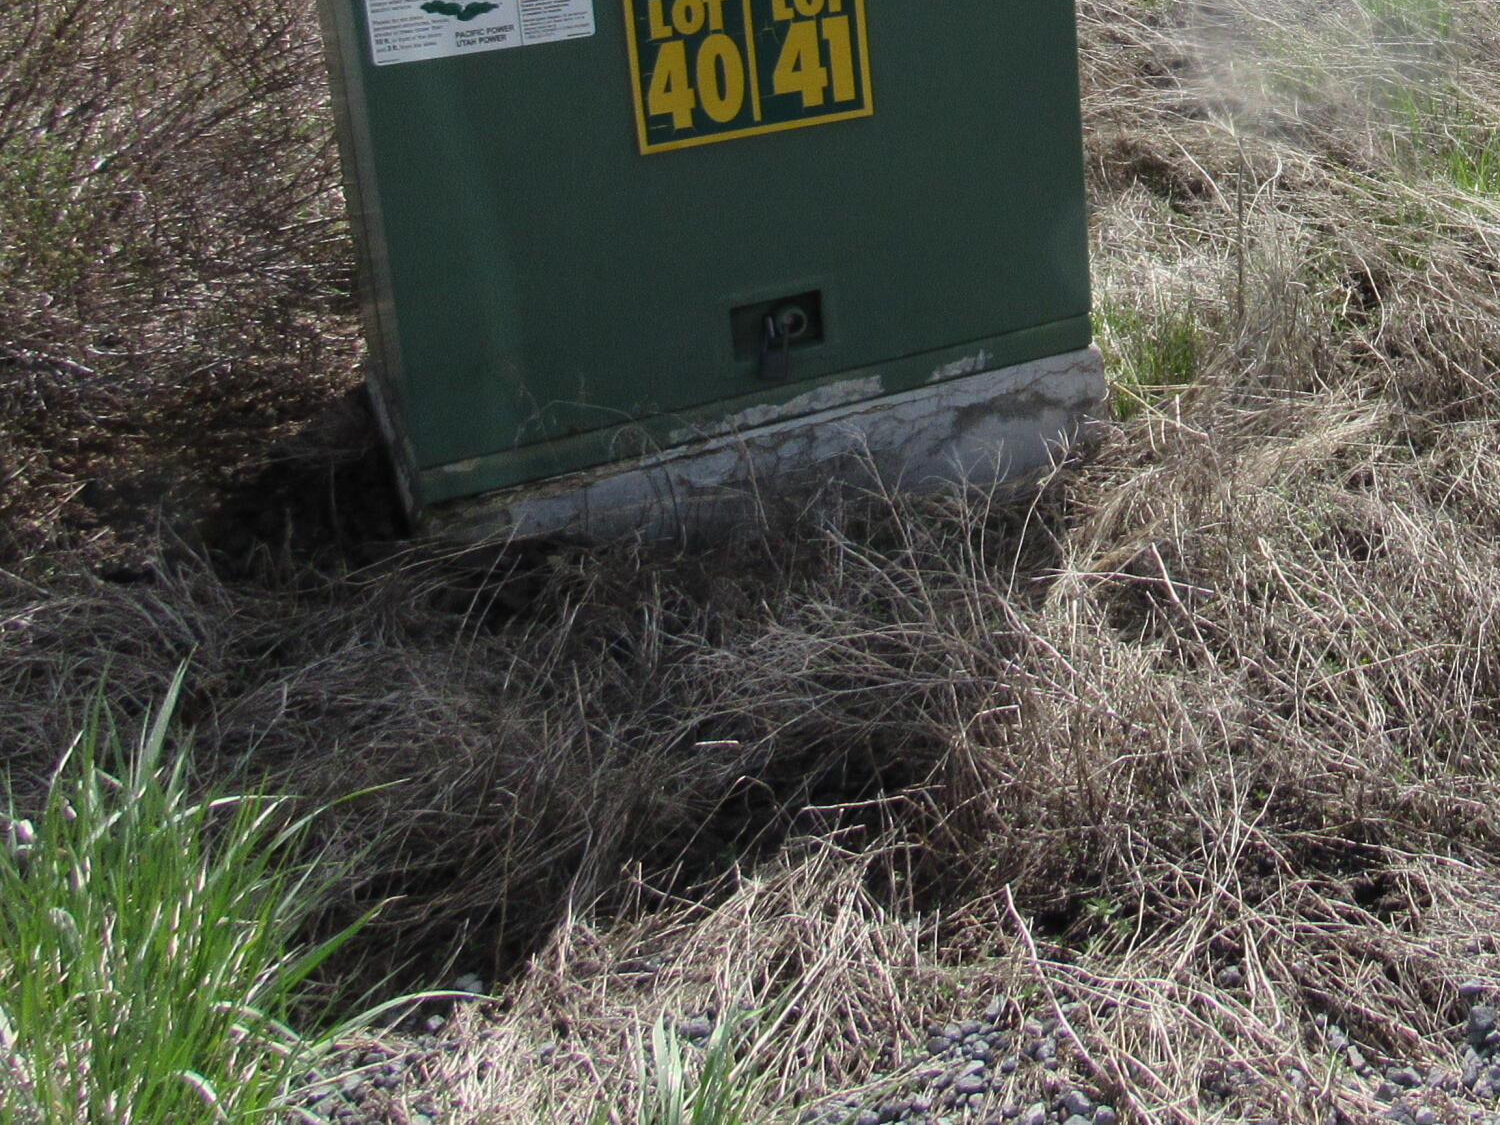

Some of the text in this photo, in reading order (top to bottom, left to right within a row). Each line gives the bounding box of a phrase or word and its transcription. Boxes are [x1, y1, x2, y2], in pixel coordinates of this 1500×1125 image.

[455, 24, 514, 38] PACIFIC POWER
[478, 34, 507, 45] POWER
[648, 33, 744, 130] 40
[773, 15, 856, 108] 41
